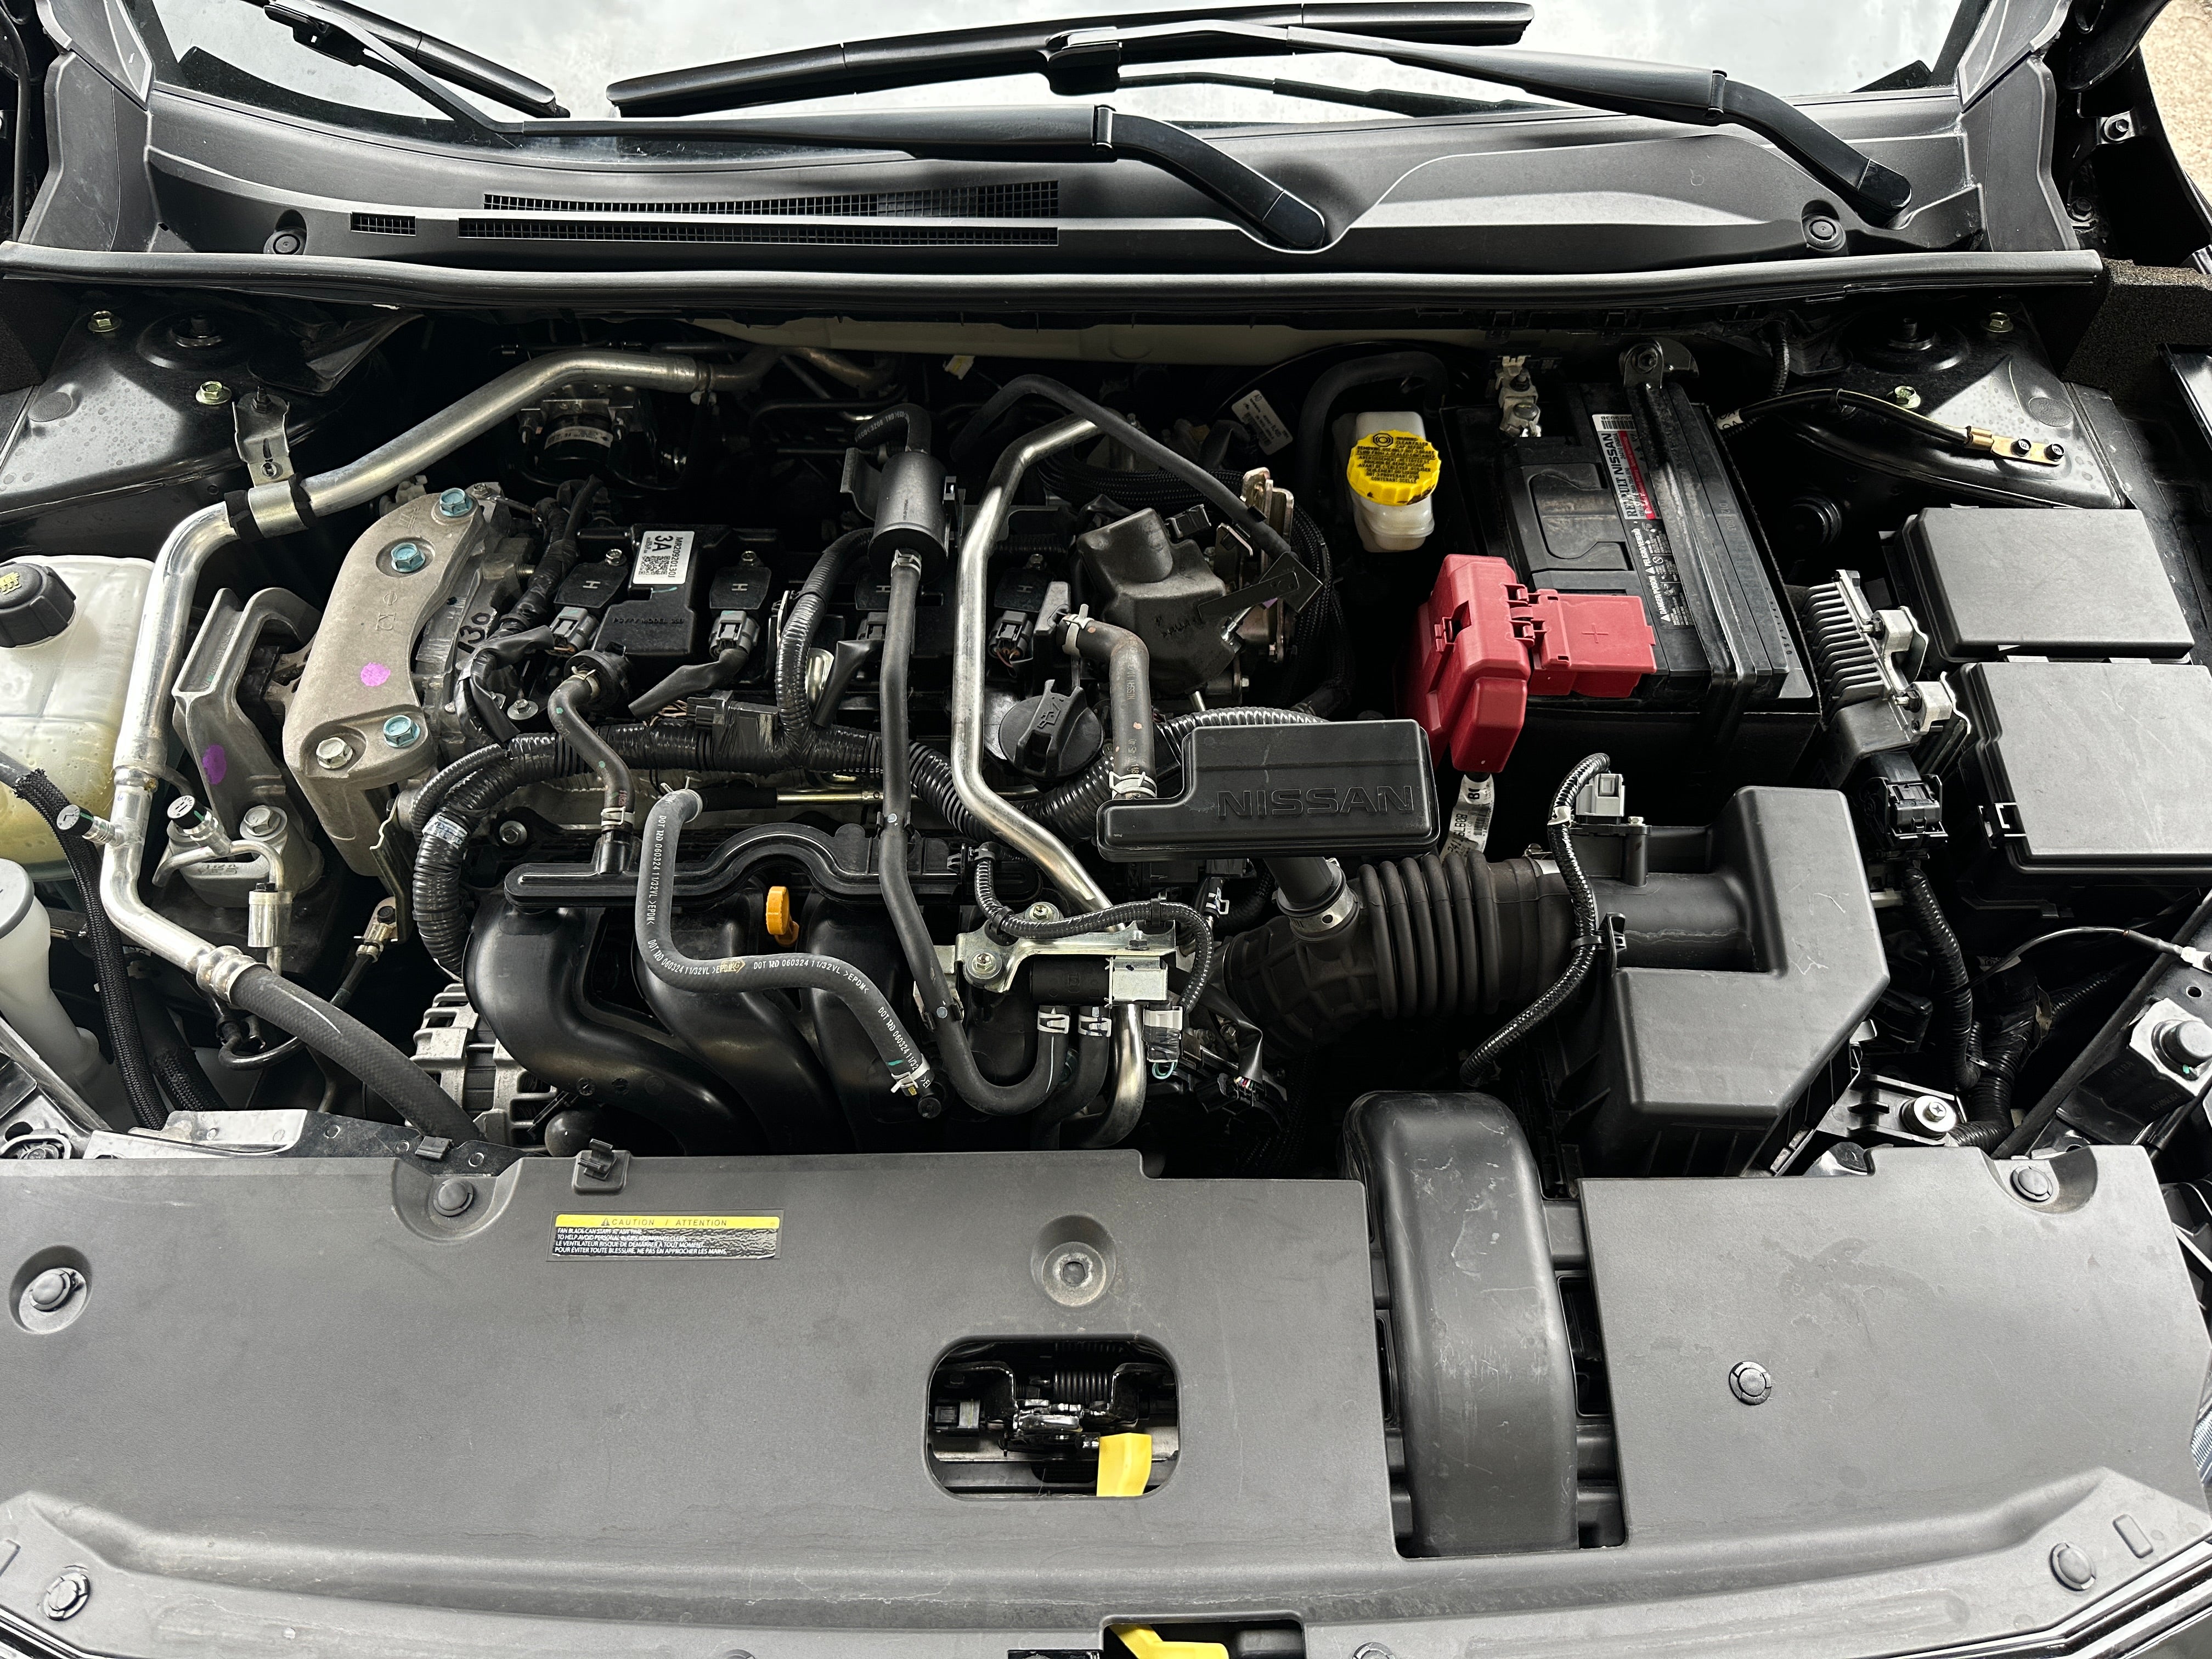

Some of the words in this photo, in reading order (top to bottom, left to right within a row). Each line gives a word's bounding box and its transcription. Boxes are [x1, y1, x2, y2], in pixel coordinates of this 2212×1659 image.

[1601, 433, 1624, 475] NISSAN
[652, 535, 674, 552] 3A
[1649, 575, 1667, 614] DANGER/POISON
[1217, 786, 1414, 817] NISSAN
[658, 815, 667, 828] DOT
[652, 843, 663, 870] 060324
[647, 939, 659, 952] DOT
[661, 958, 685, 974] 060324
[754, 961, 766, 969] DOT
[878, 1006, 889, 1020] DOT
[893, 1030, 910, 1054] 060324
